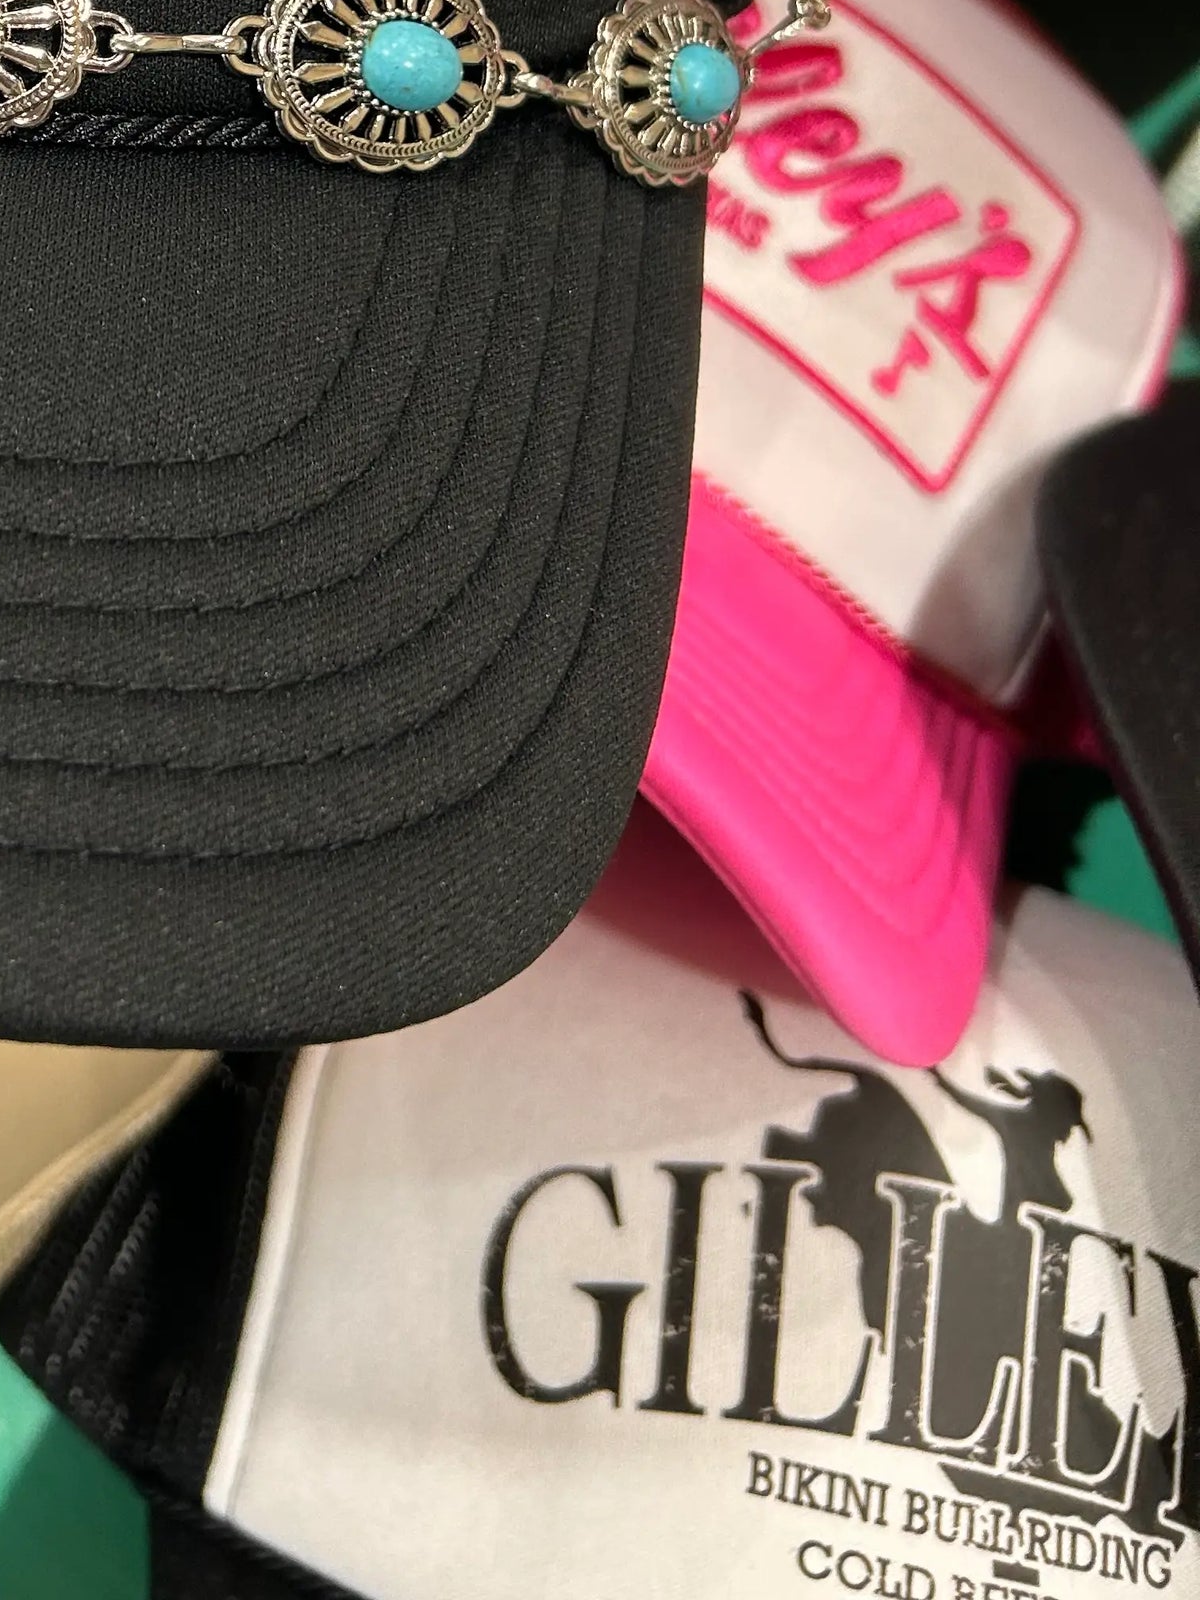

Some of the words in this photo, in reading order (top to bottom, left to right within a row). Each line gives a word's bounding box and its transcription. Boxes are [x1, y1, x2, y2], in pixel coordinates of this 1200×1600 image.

[747, 1450, 892, 1527] BIKINI
[903, 1488, 1014, 1557] BULL
[1024, 1514, 1172, 1590] RIDING
[797, 1539, 937, 1600] COLD
